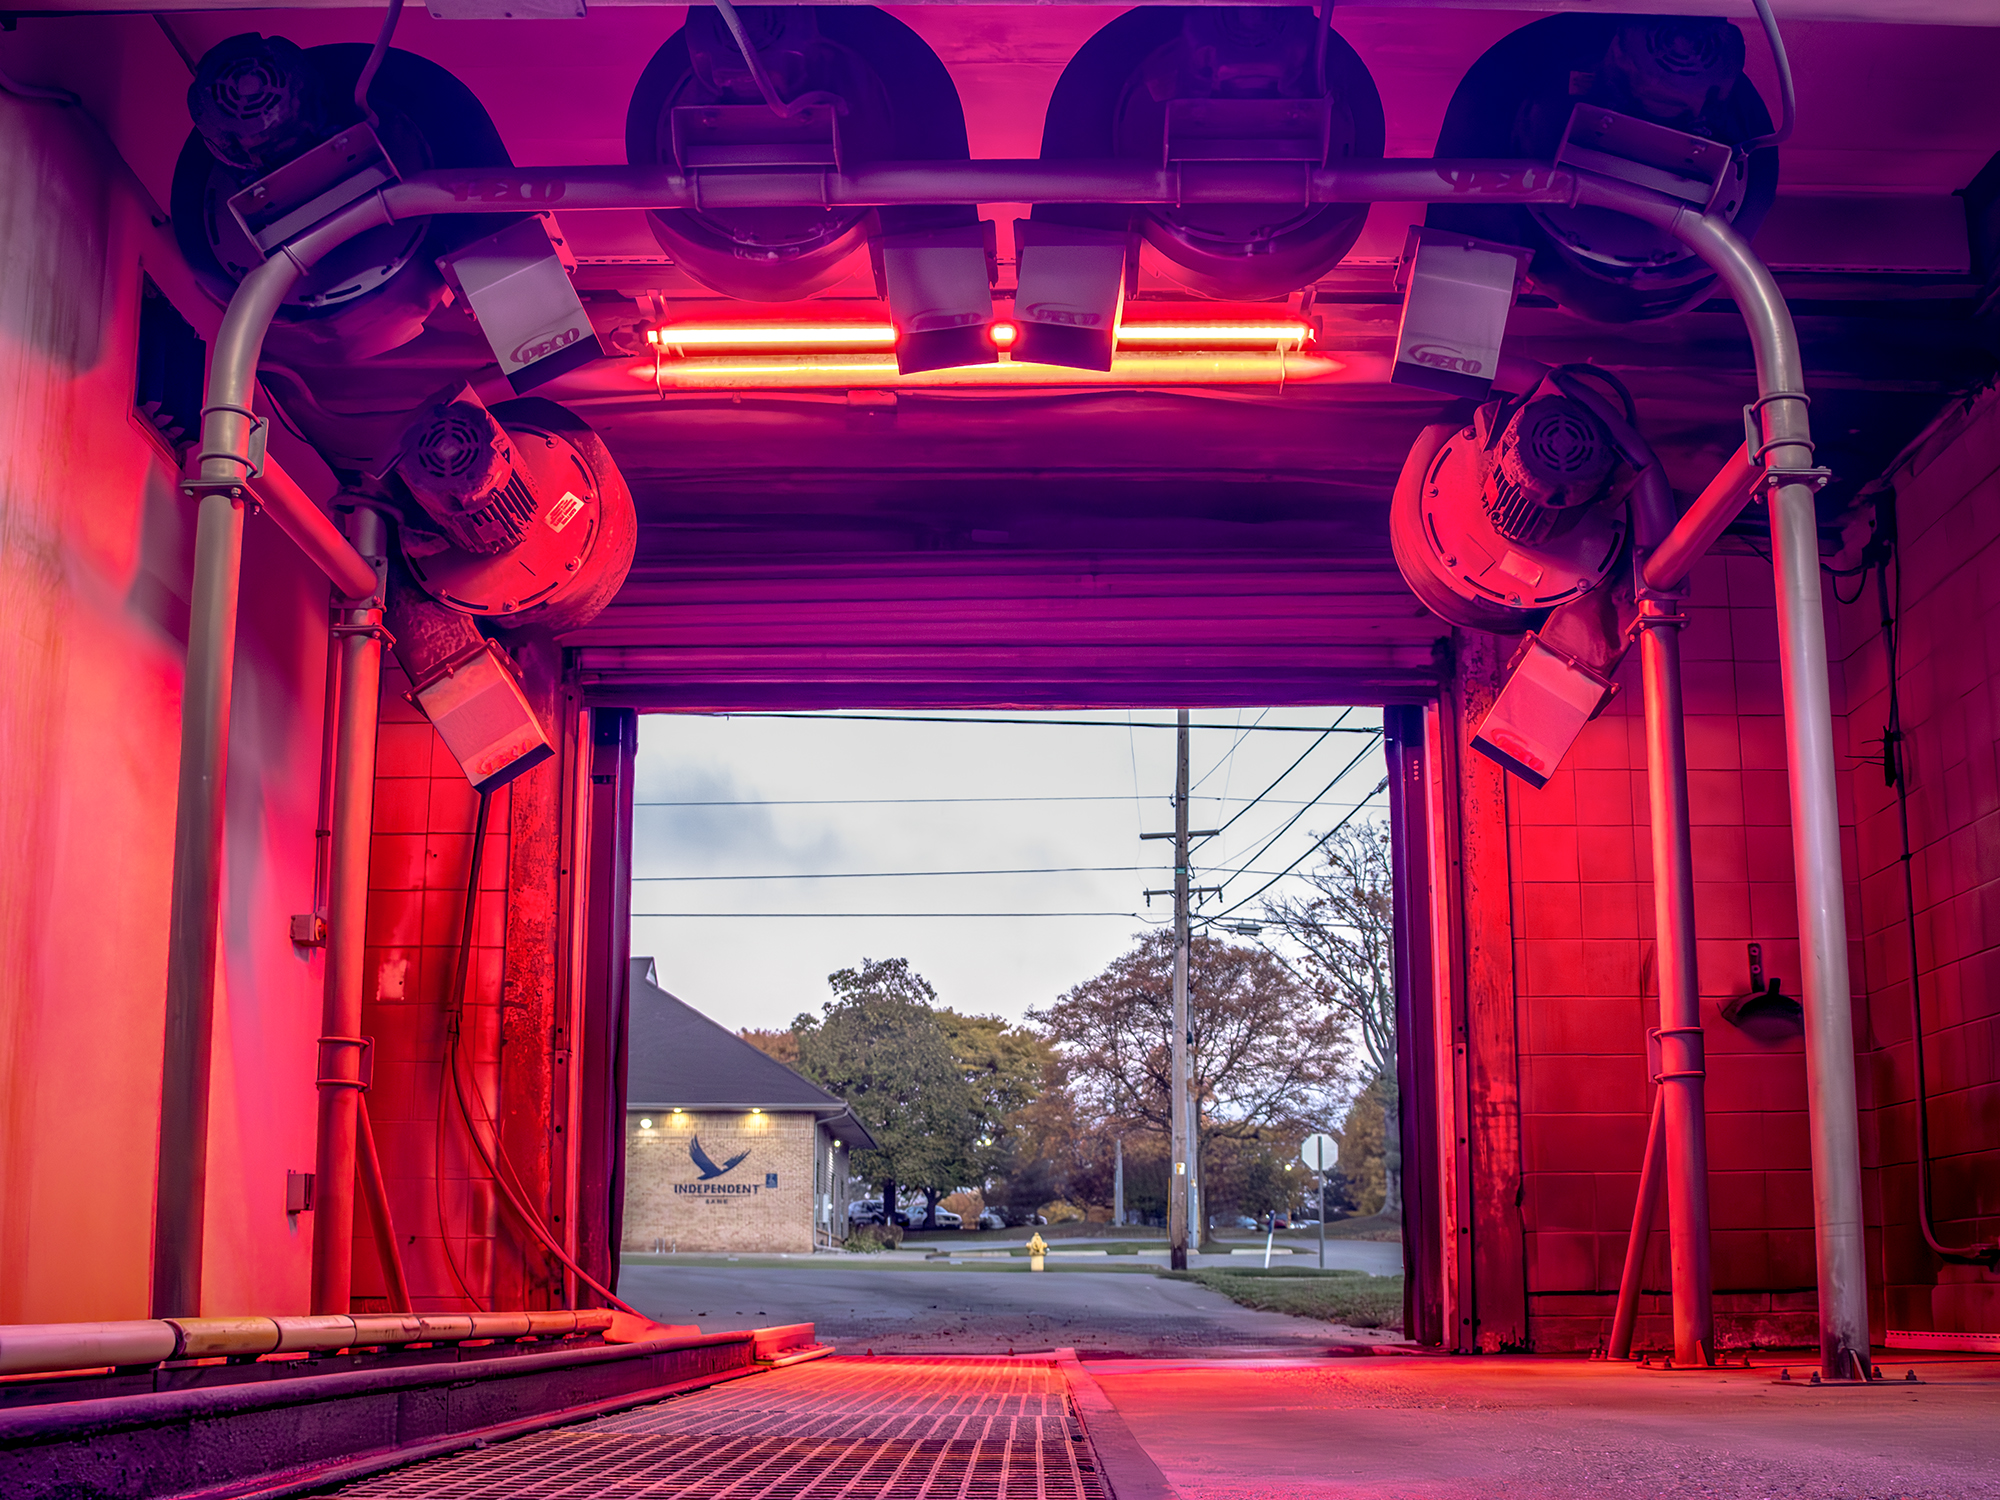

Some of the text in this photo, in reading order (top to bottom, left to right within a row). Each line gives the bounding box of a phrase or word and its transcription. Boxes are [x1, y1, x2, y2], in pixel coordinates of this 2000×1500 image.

[521, 326, 581, 365] PECO
[1418, 350, 1483, 375] PECO
[674, 1183, 760, 1195] INDEPENDENT
